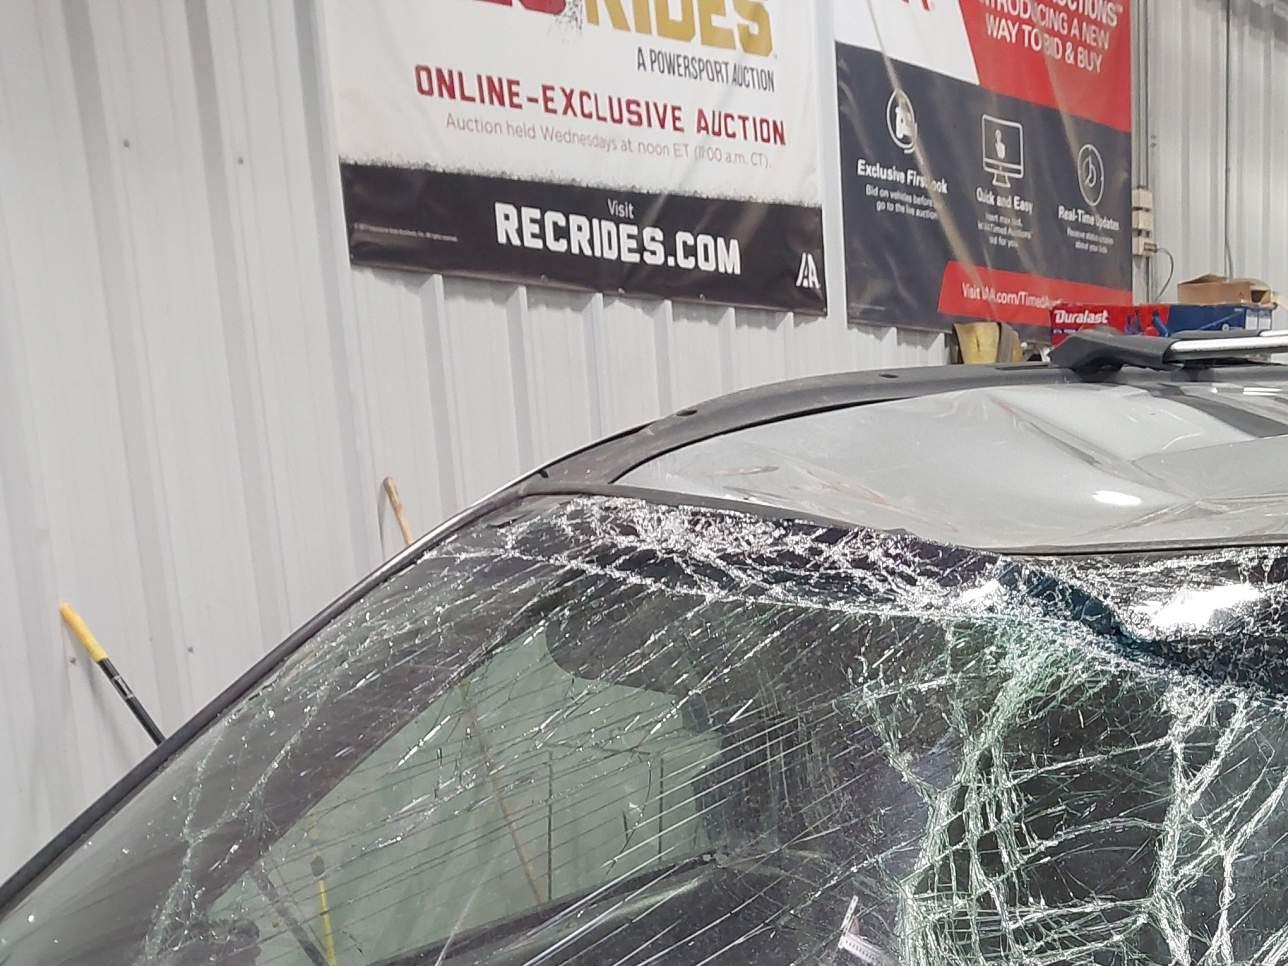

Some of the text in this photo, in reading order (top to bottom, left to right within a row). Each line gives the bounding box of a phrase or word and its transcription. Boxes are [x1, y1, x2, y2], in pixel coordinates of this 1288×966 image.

[985, 13, 1103, 73] WAY TO BID & BUY
[1070, 17, 1080, 40] A
[1082, 21, 1110, 50] NEW
[637, 47, 775, 93] A POWERSPORT AUCTION
[415, 64, 787, 146] ONLINE-EXCLUSIVE AUCTION
[446, 112, 503, 135] Auction
[506, 122, 537, 140] held
[540, 125, 617, 153] Wednesdays
[621, 138, 633, 153] at
[638, 141, 669, 158] noon
[674, 143, 690, 158] ET
[857, 158, 905, 184] Exclusive
[906, 169, 929, 188] Firs
[865, 184, 878, 197] Bid
[976, 186, 995, 206] Quick
[1013, 195, 1033, 216] Easy
[607, 198, 635, 219] Visit
[876, 200, 886, 212] go
[1058, 204, 1094, 227] Real-Time
[494, 201, 741, 275] RECRIDES.COM
[961, 282, 981, 300] Visit
[1054, 309, 1109, 324] Duralast
